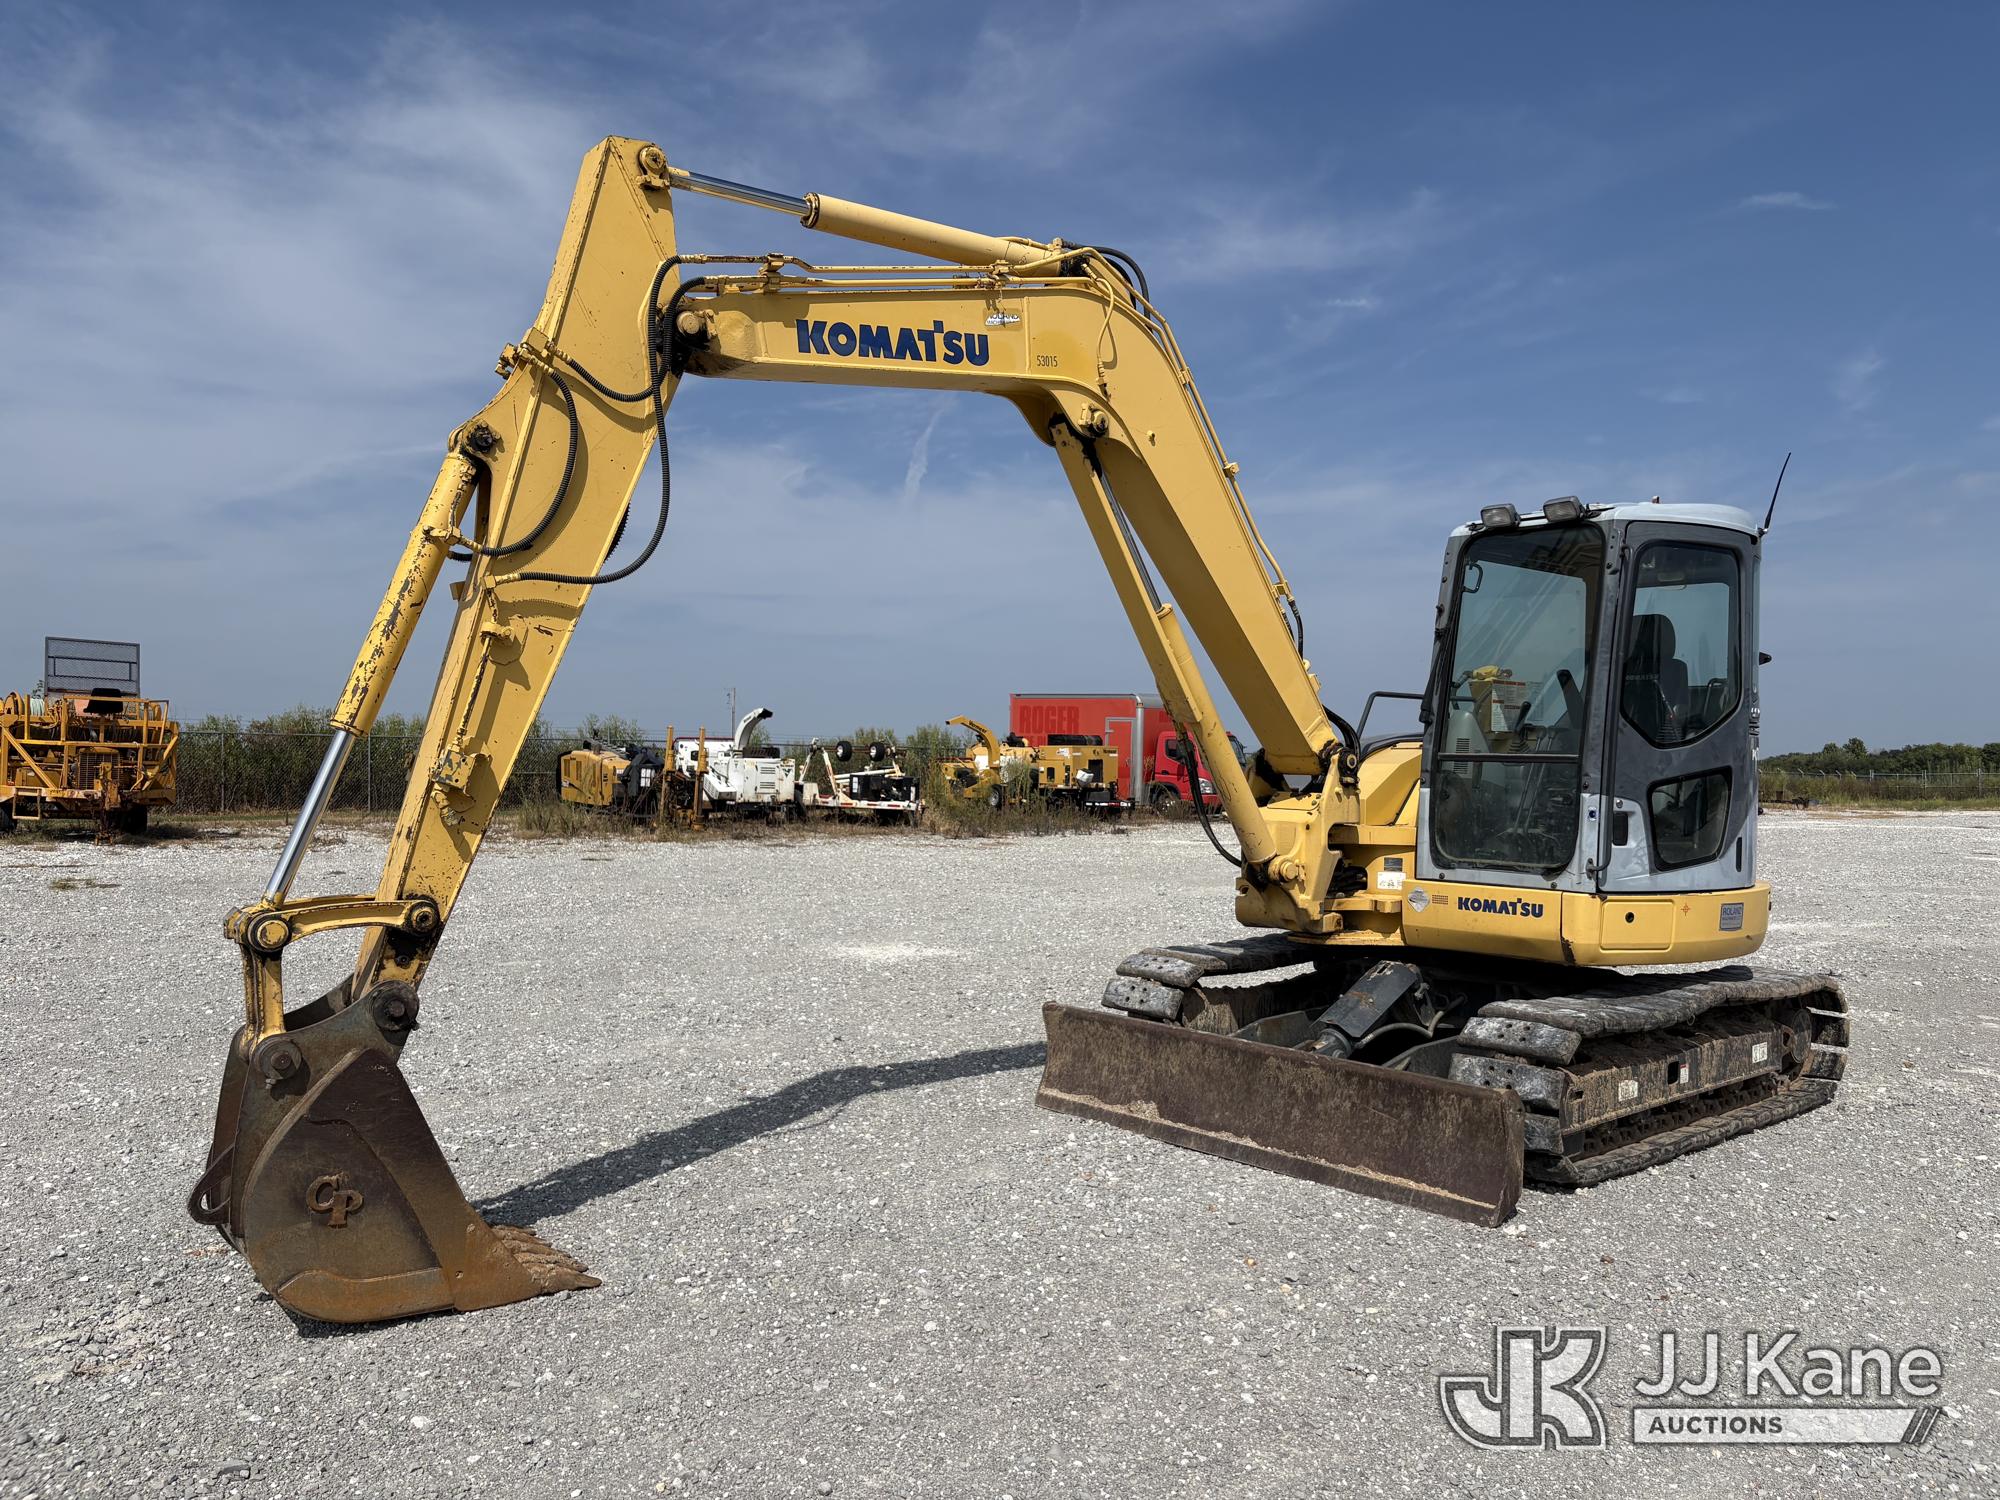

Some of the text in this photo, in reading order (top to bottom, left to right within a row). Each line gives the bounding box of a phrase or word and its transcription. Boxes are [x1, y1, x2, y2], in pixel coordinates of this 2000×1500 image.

[796, 319, 990, 366] KOMATSU
[1036, 354, 1058, 368] 53015
[1019, 705, 1080, 734] ROGER
[1457, 897, 1544, 918] KOMATSU
